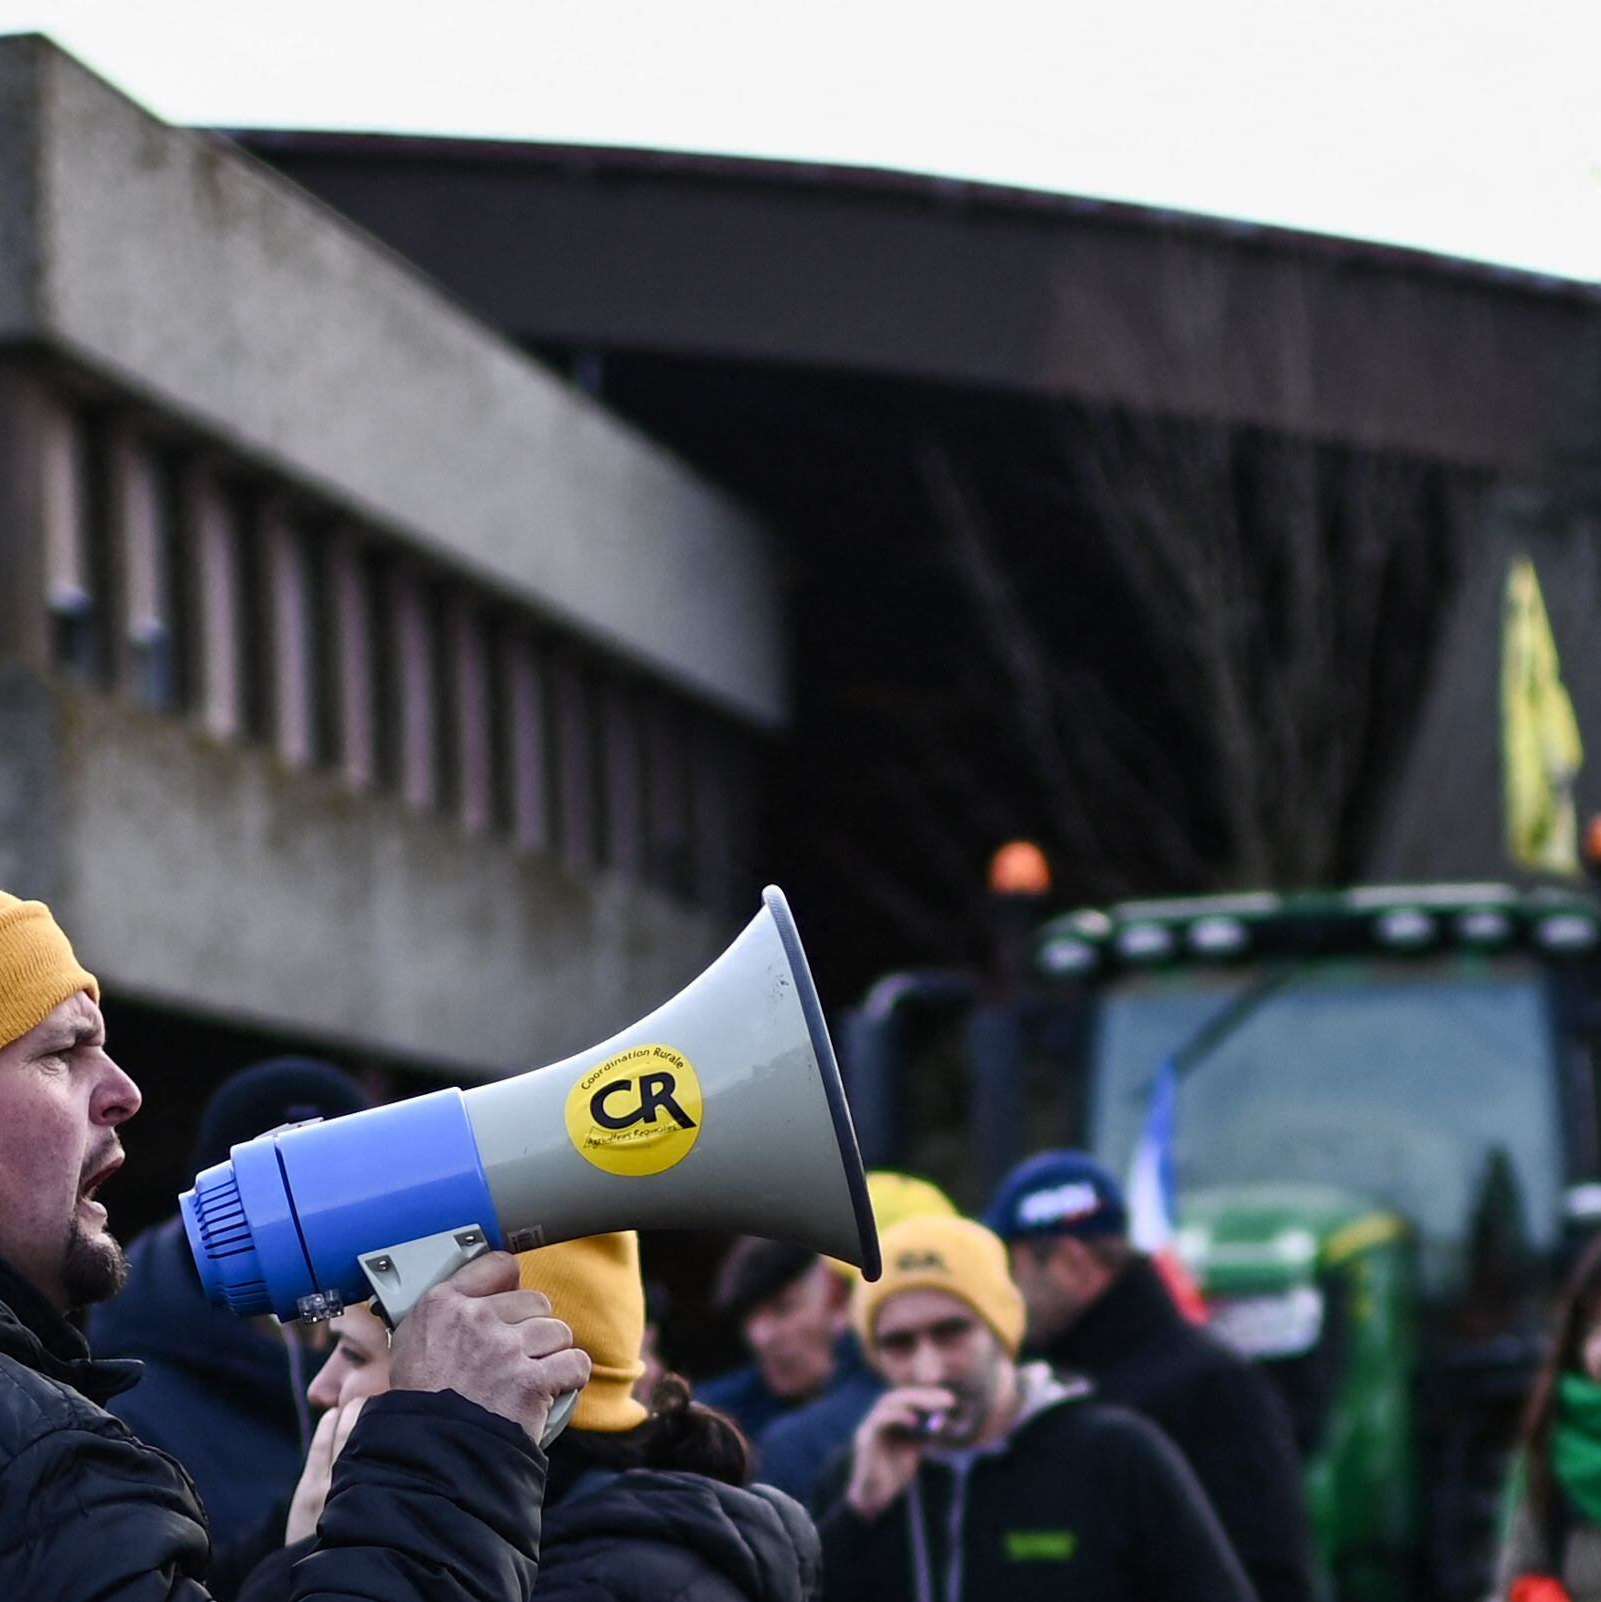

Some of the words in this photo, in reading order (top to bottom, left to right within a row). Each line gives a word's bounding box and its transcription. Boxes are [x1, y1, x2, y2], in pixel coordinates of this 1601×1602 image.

[581, 1049, 650, 1090] Coordination
[653, 1047, 684, 1069] Rurale
[590, 1071, 697, 1130] CR
